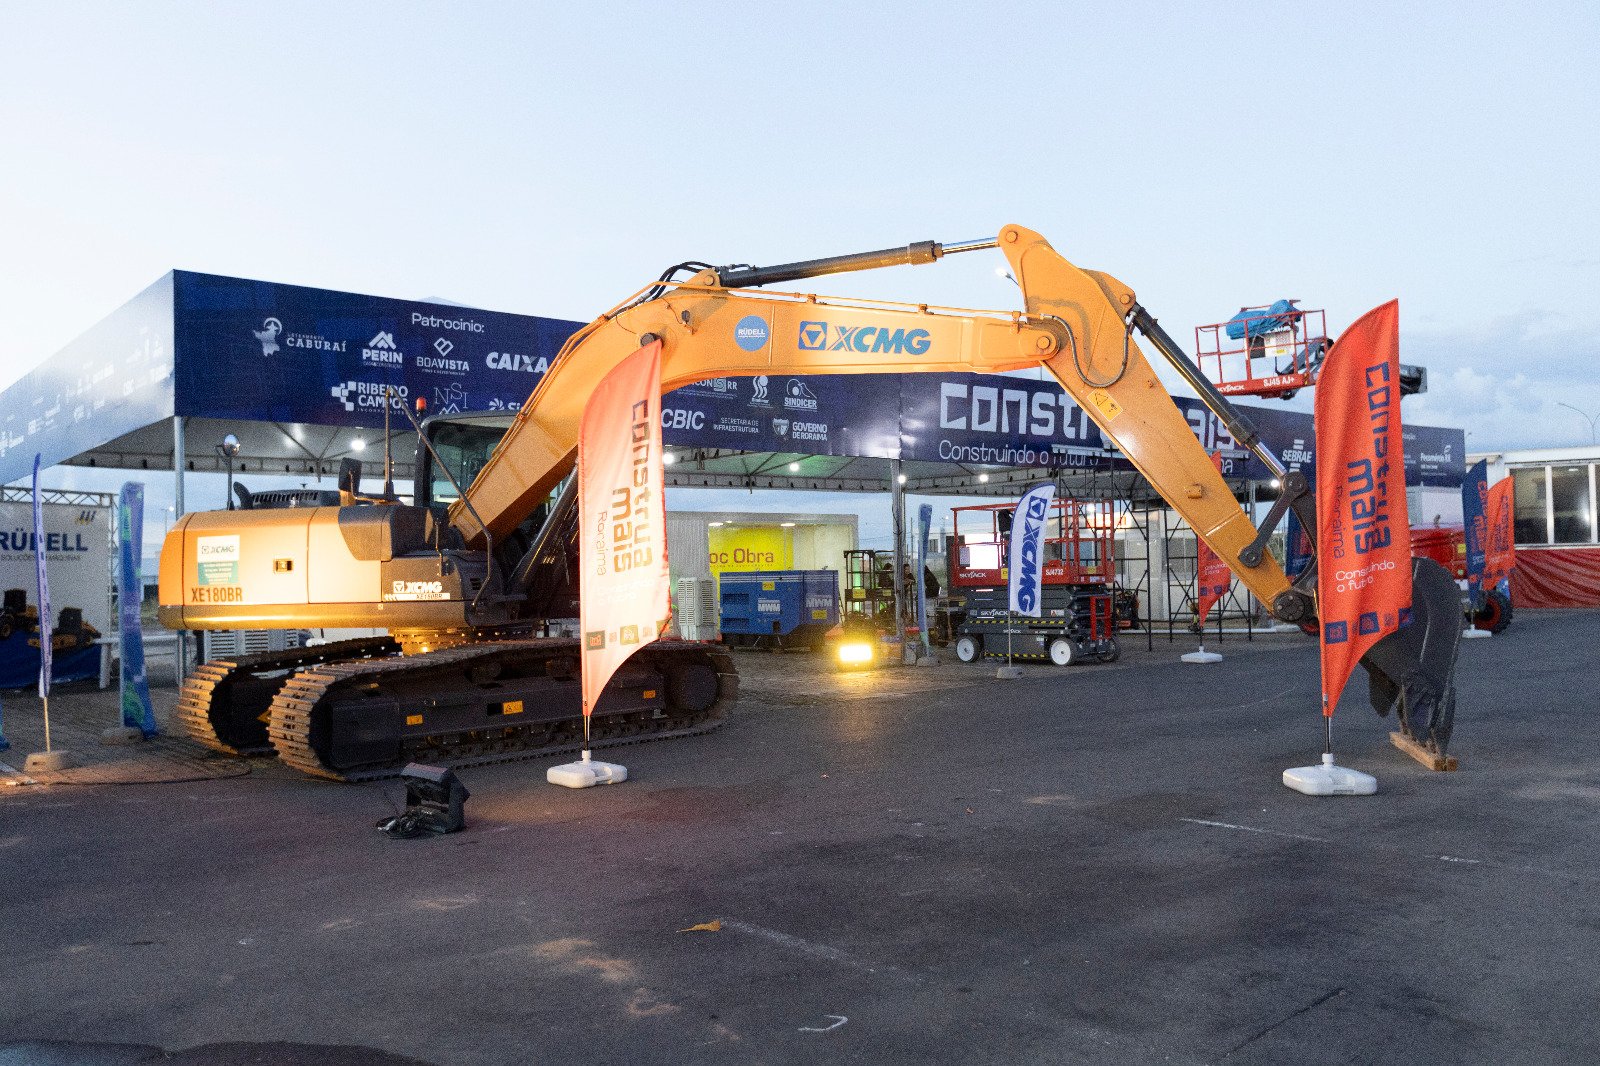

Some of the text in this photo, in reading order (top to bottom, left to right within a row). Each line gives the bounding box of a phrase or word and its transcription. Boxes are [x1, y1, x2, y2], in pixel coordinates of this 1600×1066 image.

[738, 327, 766, 336] RÜDELL
[286, 337, 347, 352] CABURAÍ
[828, 325, 931, 356] XCMG
[362, 349, 403, 364] PERIN
[485, 352, 549, 374] CAIXA
[357, 381, 409, 398] RIBEO
[1216, 384, 1245, 393] KYJACK
[784, 396, 818, 408] SINDICER
[661, 408, 706, 431] CBIC
[720, 417, 751, 426] SECRETARIA
[713, 424, 759, 434] INFRAESTRUTURA
[792, 421, 828, 434] GOVERNO
[939, 439, 1036, 466] Construindo
[1040, 450, 1049, 465] o
[1282, 449, 1313, 463] SEBRAE
[632, 399, 653, 569] construa
[1347, 458, 1376, 555] mais
[612, 487, 633, 573] mais
[596, 510, 608, 577] Roraima
[709, 548, 774, 564] oc Obra
[1017, 519, 1041, 613] XCMG
[959, 570, 987, 578] SKYJACK
[191, 586, 243, 603] XE180BR
[404, 581, 443, 594] XCMG
[1336, 584, 1345, 593] o
[980, 608, 1008, 616] SKYJACK
